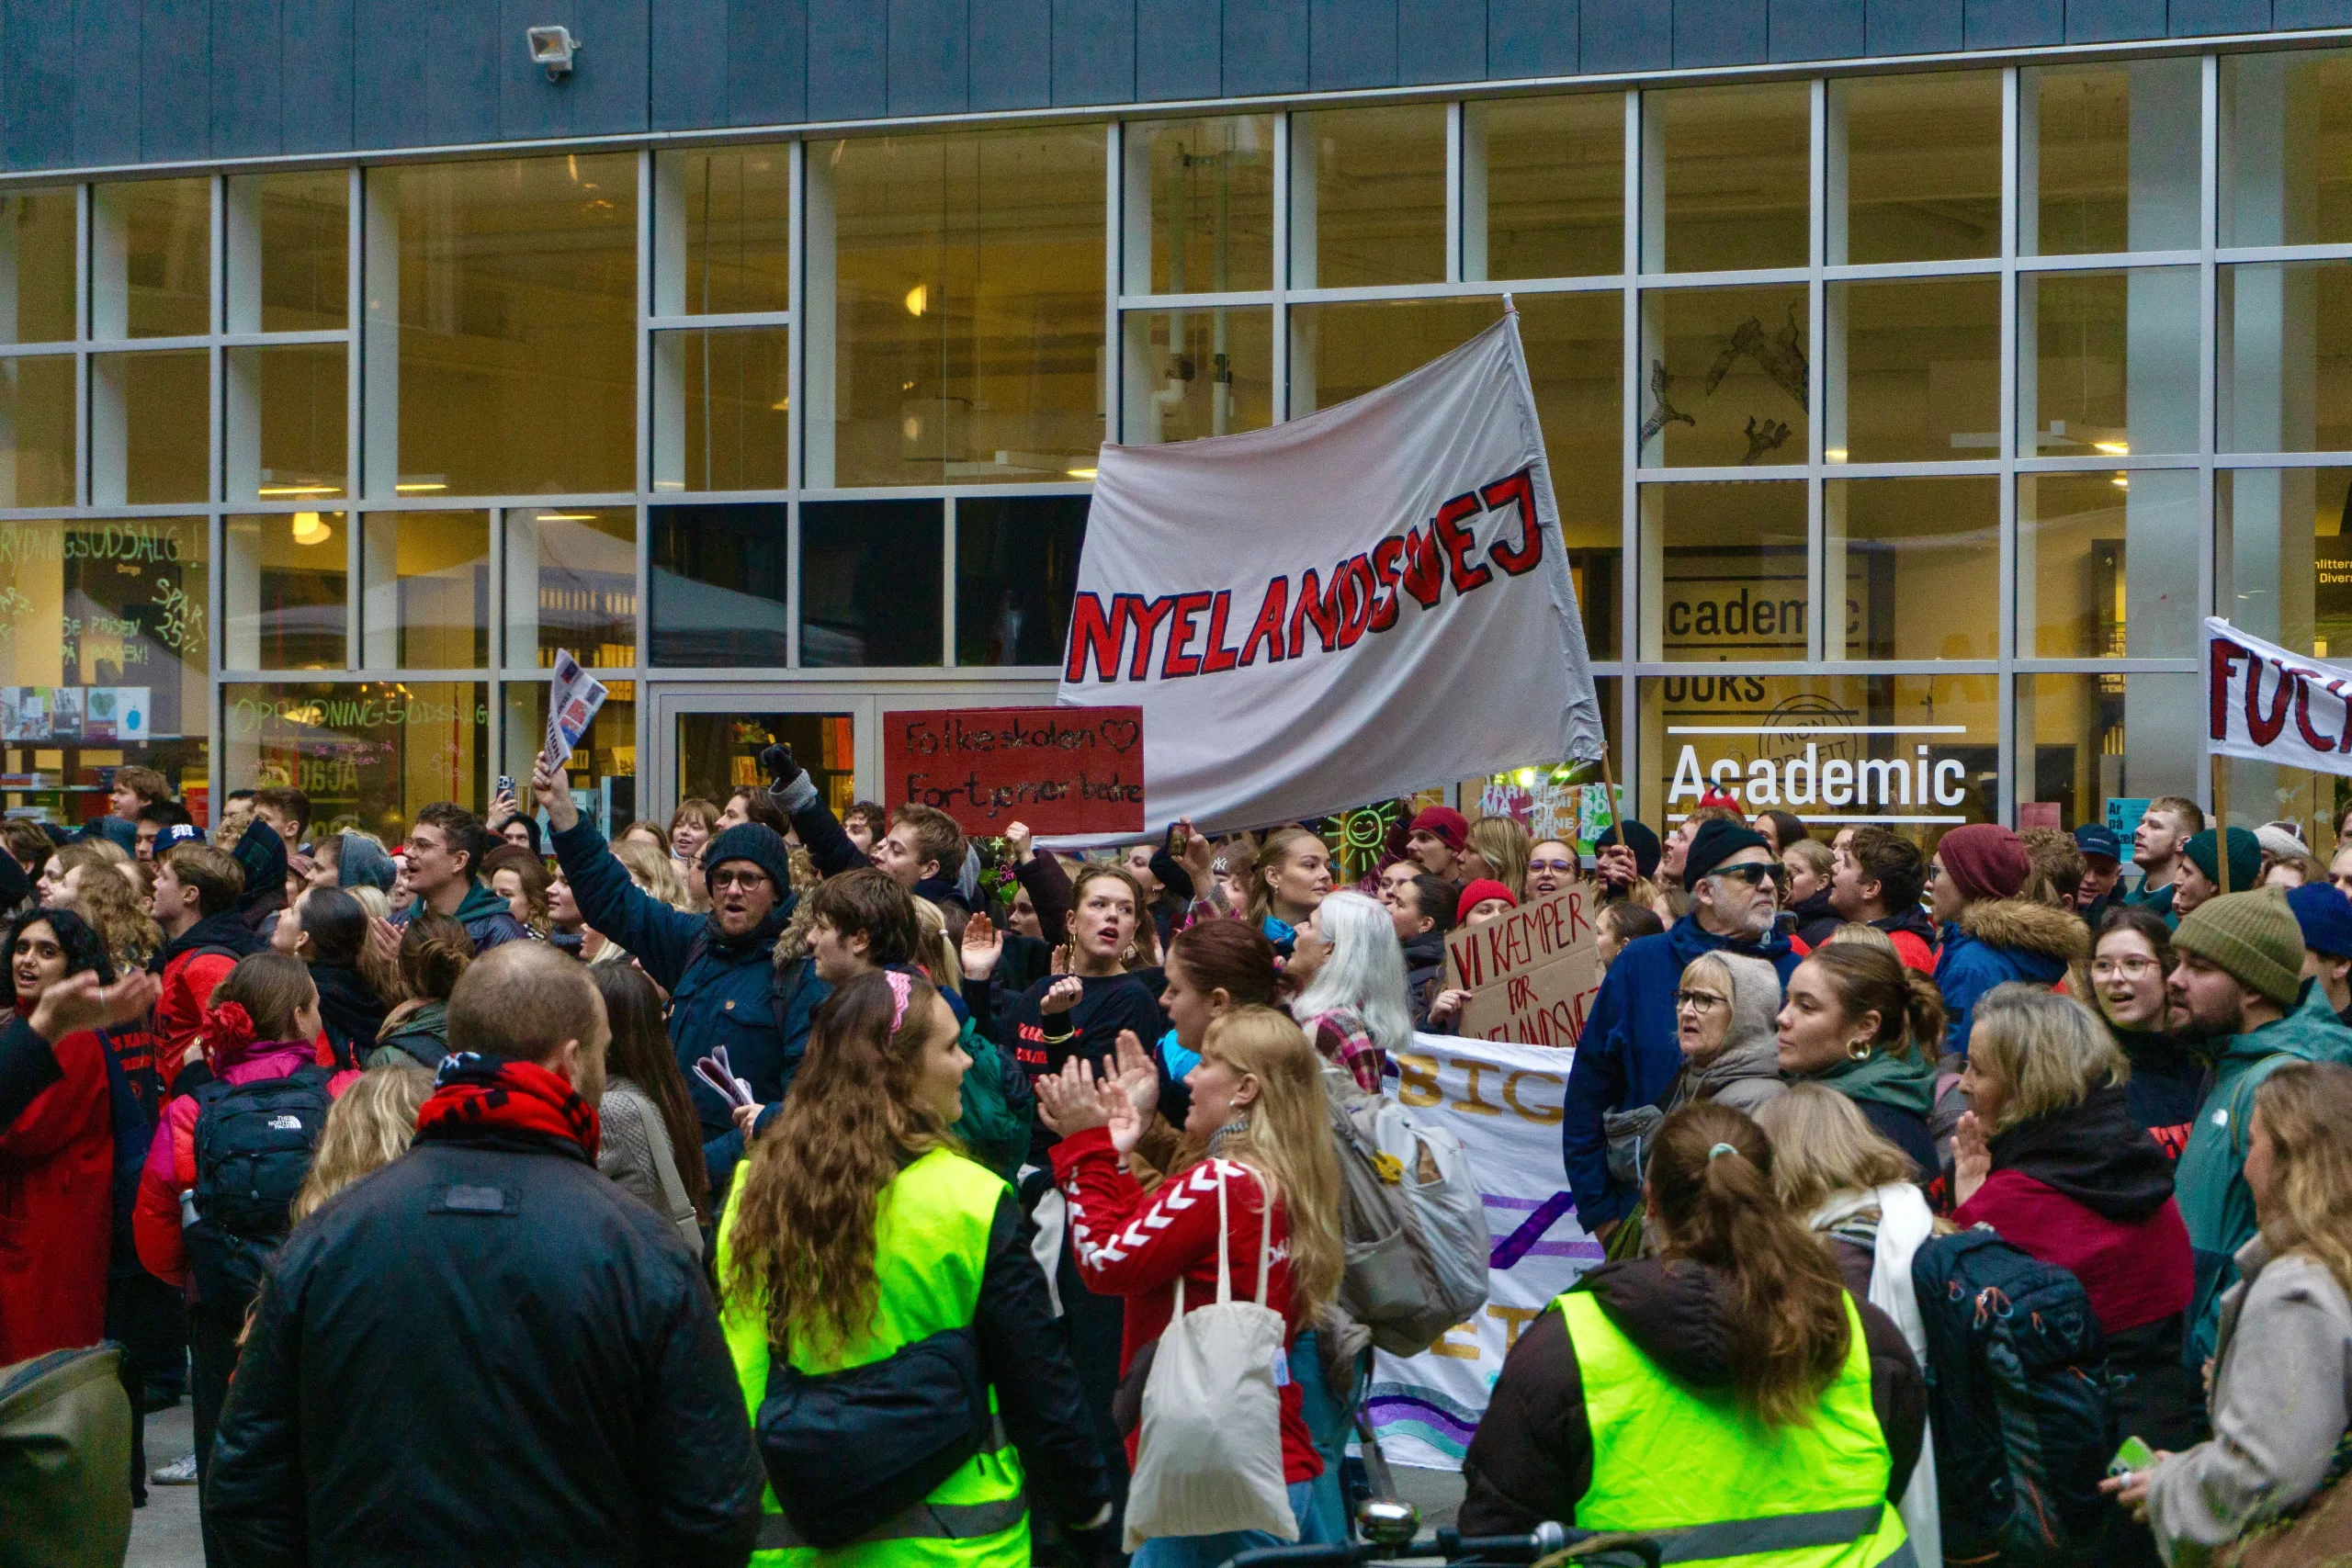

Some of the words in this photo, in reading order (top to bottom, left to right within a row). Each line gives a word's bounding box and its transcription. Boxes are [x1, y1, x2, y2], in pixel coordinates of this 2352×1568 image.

[1065, 468, 1544, 683] NYELANDSVEJ
[906, 717, 1095, 756] Folkeskolen
[1668, 742, 1964, 806] Academic
[1451, 933, 1483, 990] VI
[1489, 892, 1591, 976] KÆMPER
